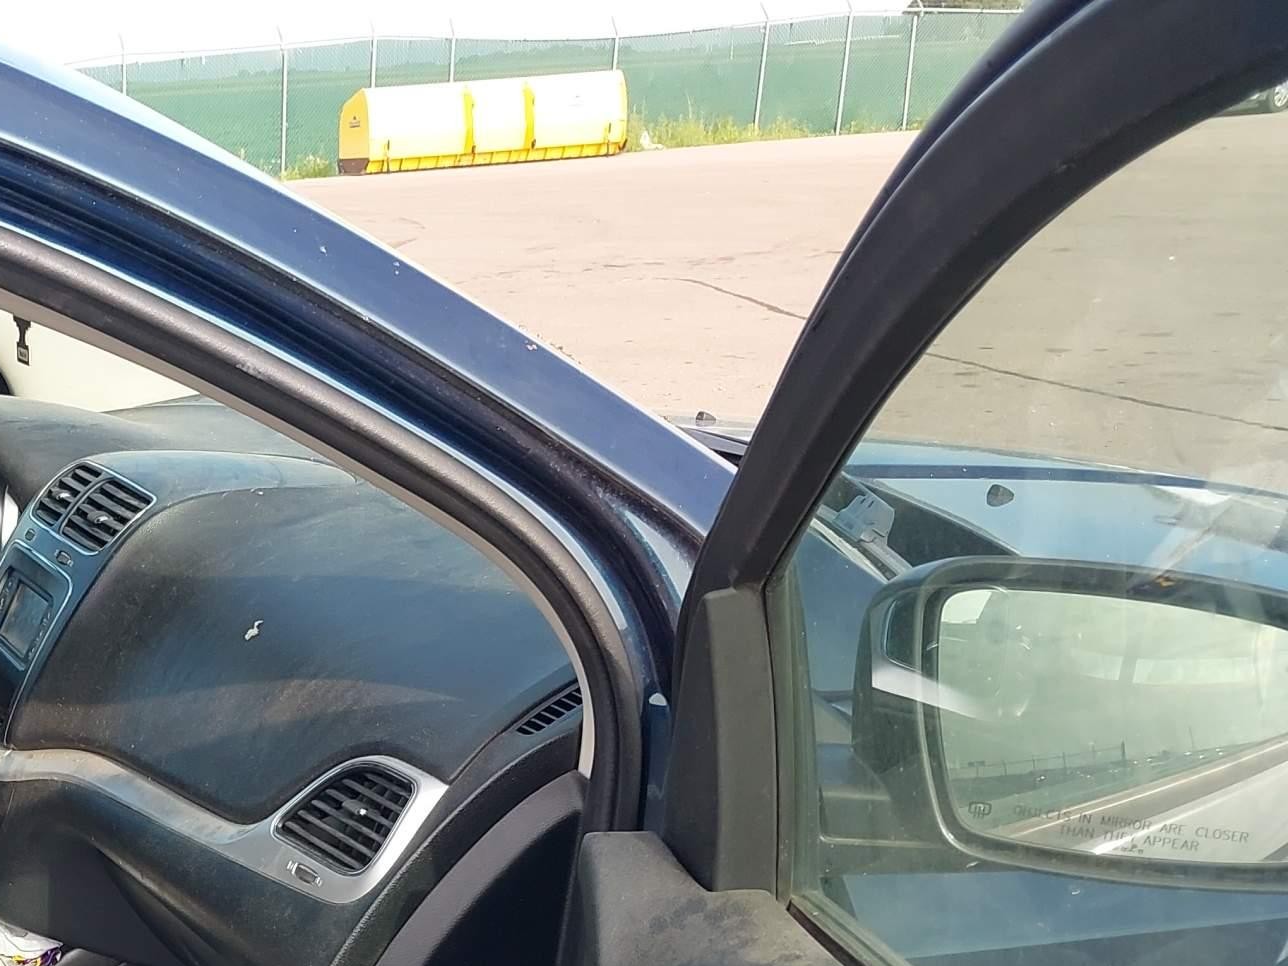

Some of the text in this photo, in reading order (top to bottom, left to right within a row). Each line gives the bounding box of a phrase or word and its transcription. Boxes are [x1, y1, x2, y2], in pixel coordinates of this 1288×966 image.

[1060, 825, 1096, 840] THAN
[1143, 835, 1201, 852] APPEAR
[1078, 813, 1093, 825] IN
[1100, 815, 1153, 832] MIRROR
[1159, 823, 1187, 836] ARE
[1194, 826, 1250, 843] CLOSER
